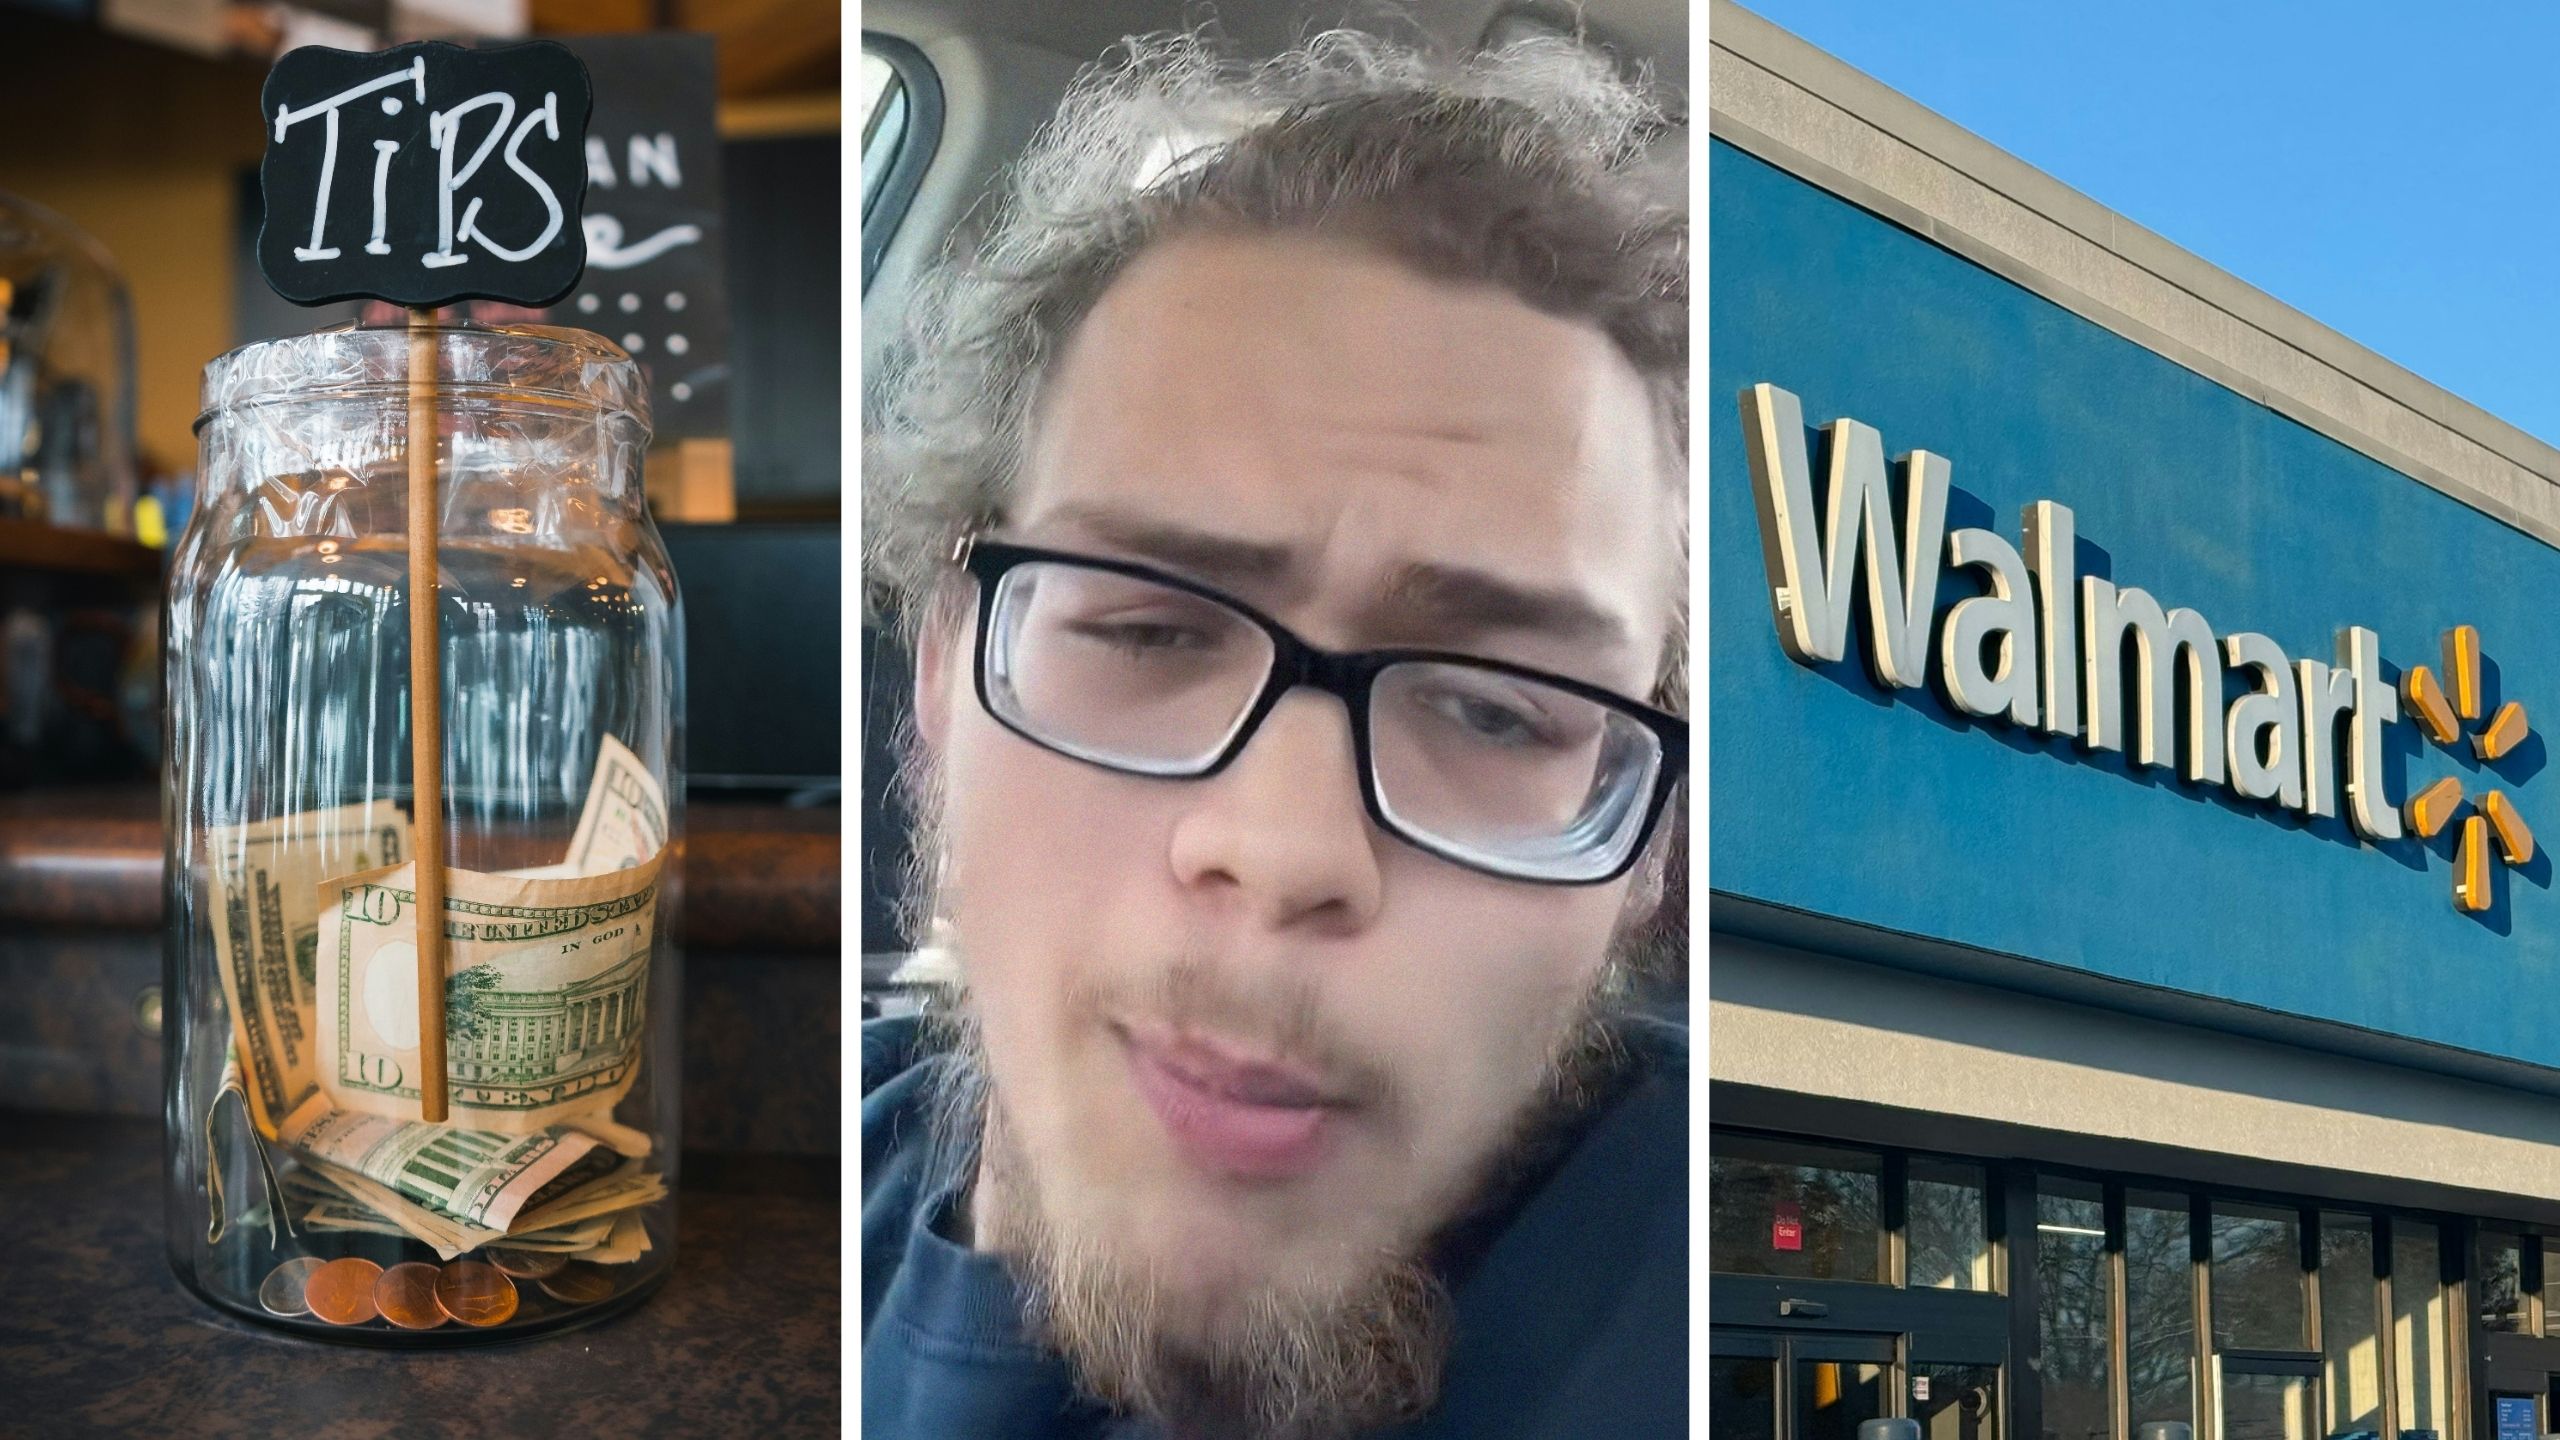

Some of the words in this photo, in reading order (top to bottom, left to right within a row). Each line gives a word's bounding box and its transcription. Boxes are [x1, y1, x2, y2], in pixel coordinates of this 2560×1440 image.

[1740, 383, 2402, 840] Walmart
[342, 884, 401, 926] 10
[477, 908, 589, 942] UNITED
[561, 941, 582, 955] IN
[592, 926, 625, 945] GOD
[343, 1053, 403, 1090] 10
